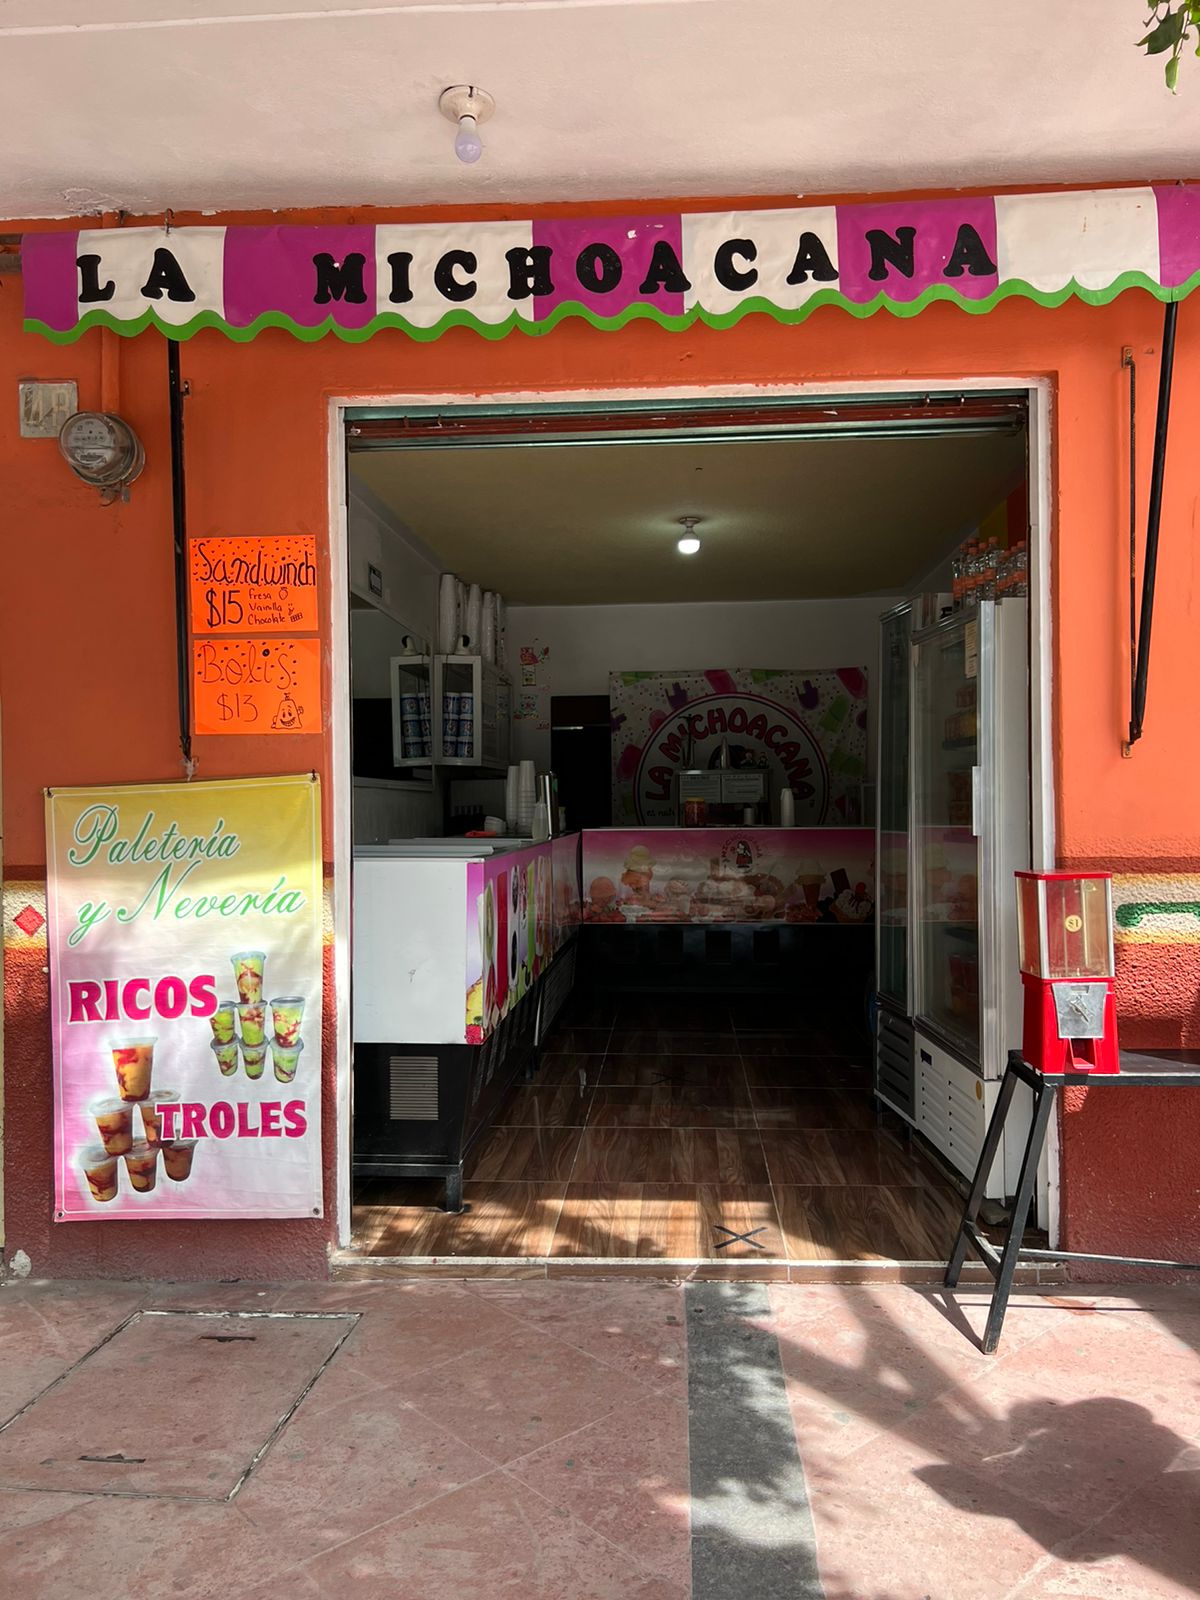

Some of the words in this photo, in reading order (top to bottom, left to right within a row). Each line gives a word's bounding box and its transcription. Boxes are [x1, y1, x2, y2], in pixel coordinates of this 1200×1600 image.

[76, 247, 196, 304] LA
[312, 223, 998, 305] MICHOACANA
[197, 542, 316, 587] Sandwinch
[205, 587, 244, 628] $15
[199, 644, 292, 690] Bolis
[216, 693, 259, 722] $13
[659, 707, 815, 800] MICHOACANA
[645, 766, 674, 800] LA
[68, 804, 240, 867] Paletería
[67, 897, 111, 949] y
[117, 860, 306, 923] Nevería
[68, 975, 218, 1023] RICOS
[156, 1100, 308, 1140] TROLES
